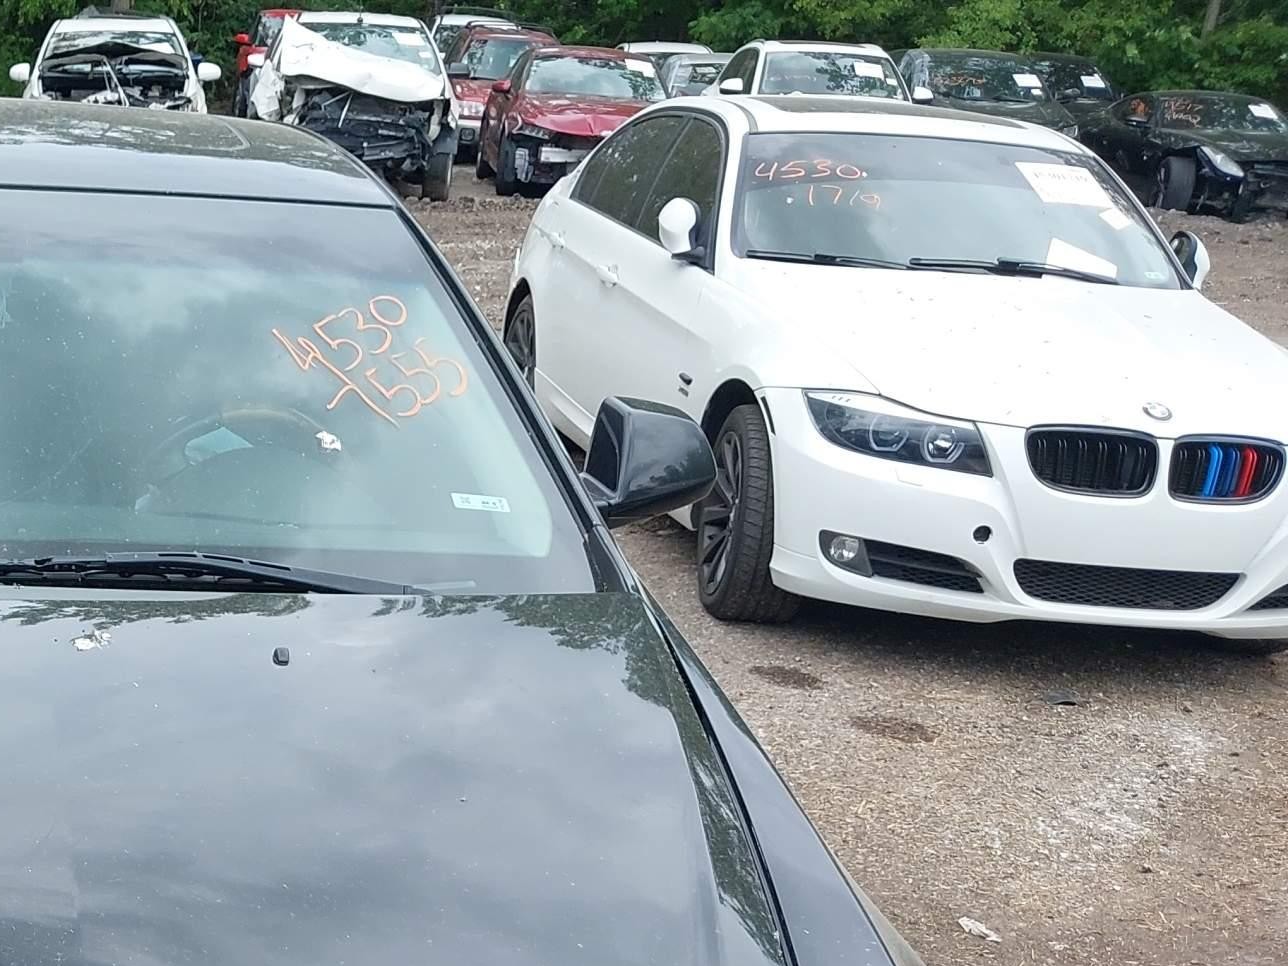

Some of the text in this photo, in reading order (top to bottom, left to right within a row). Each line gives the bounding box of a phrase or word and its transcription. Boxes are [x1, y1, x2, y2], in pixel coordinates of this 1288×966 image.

[754, 159, 861, 181] 4530
[271, 294, 409, 382] 4530
[325, 335, 469, 429] 7555
